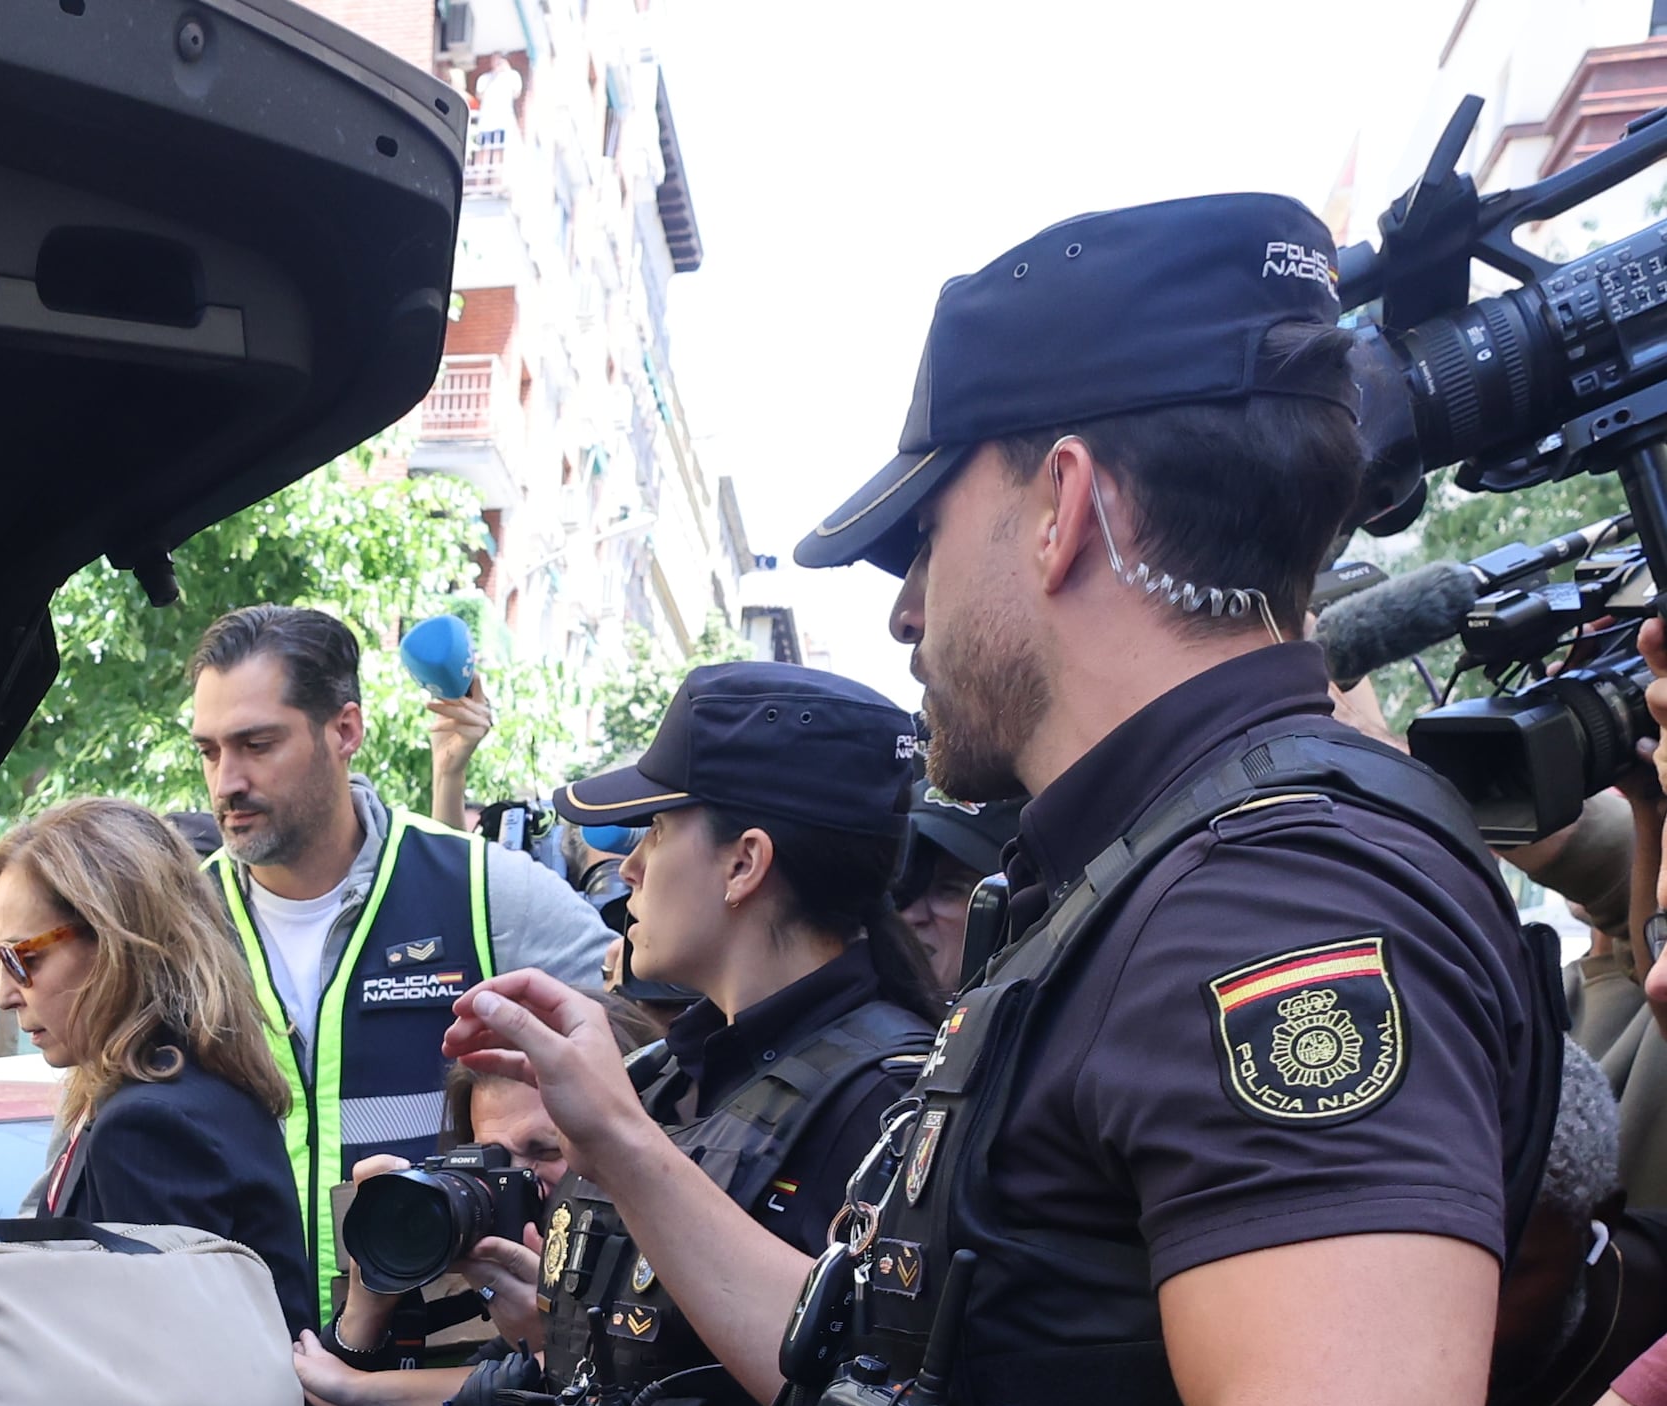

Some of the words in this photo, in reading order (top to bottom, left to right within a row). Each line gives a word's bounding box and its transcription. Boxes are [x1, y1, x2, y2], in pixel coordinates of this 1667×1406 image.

[1338, 565, 1371, 581] SONY
[363, 984, 464, 1003] NACIONAL
[1235, 1041, 1304, 1112] POLICIA
[1316, 1009, 1393, 1111] NACIONAL
[450, 1156, 478, 1164] SONY
